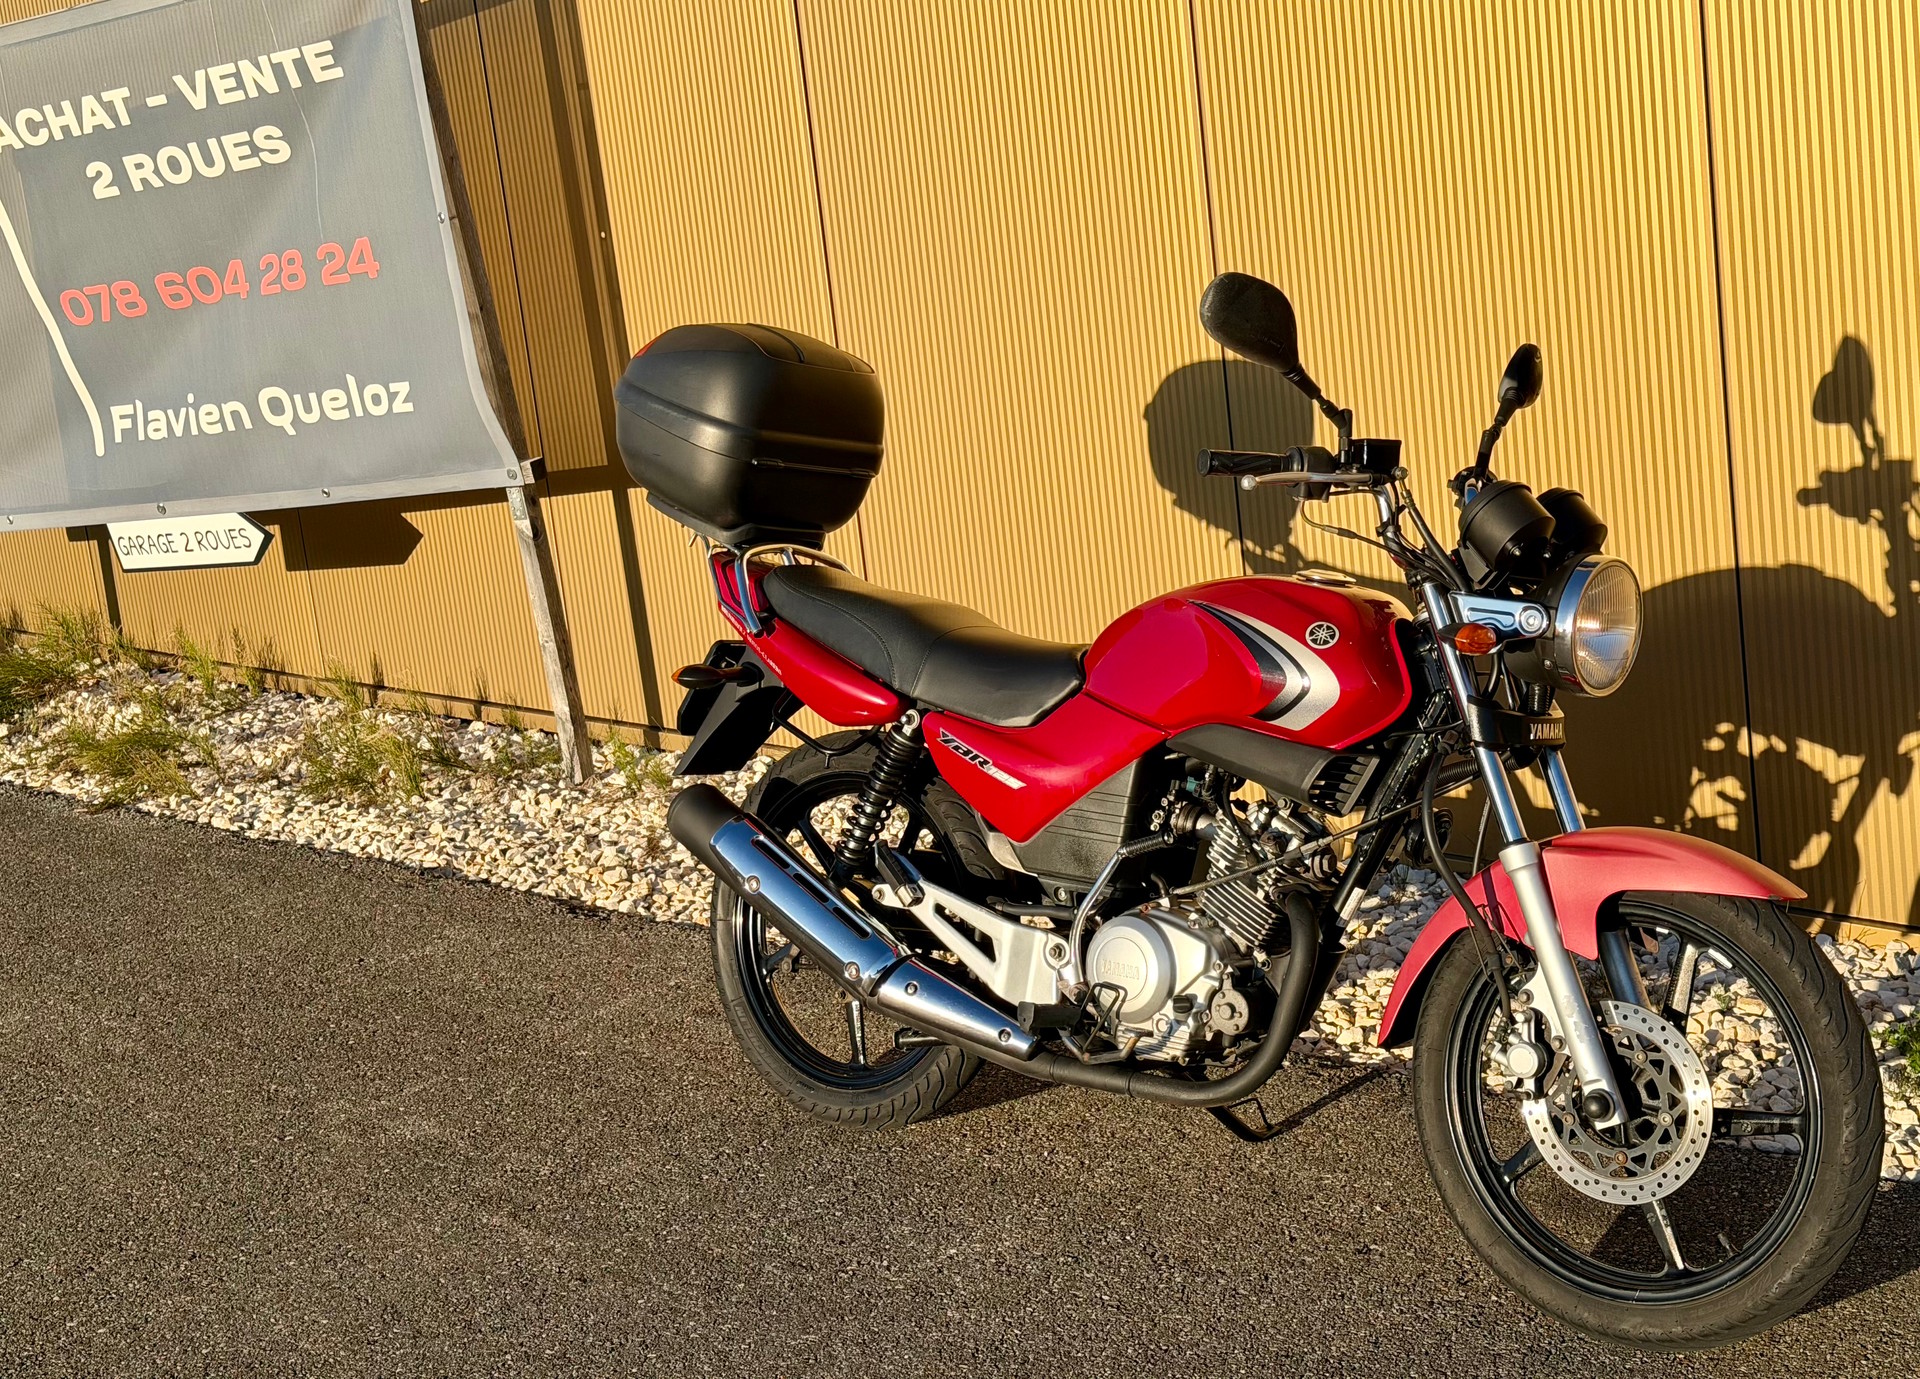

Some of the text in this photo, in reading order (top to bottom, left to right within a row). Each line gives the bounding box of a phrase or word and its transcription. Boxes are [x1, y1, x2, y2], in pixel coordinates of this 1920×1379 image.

[0, 87, 131, 153] ACHAT
[172, 40, 344, 110] VENTE
[85, 126, 292, 200] 2 ROUES
[60, 236, 380, 326] 078 604 28 24
[110, 374, 414, 443] Flavien Queloz
[117, 528, 252, 557] GARAGE 2 ROUES
[1529, 723, 1563, 740] YAMAHA
